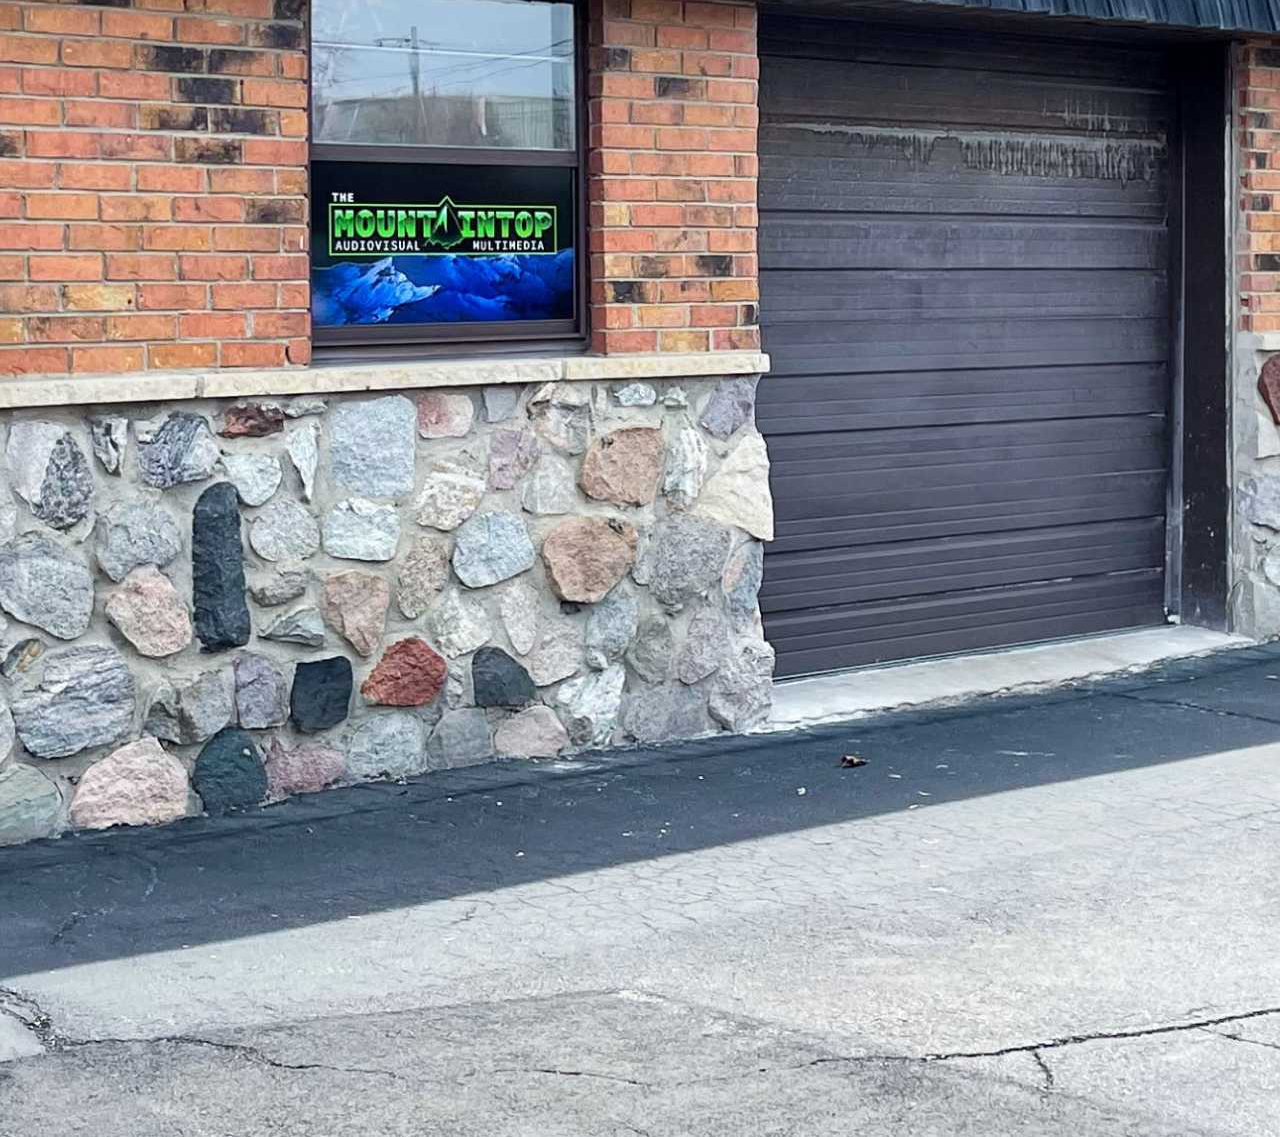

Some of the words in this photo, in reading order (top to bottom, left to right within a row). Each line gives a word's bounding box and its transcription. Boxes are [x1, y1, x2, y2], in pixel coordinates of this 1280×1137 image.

[331, 192, 355, 203] THE
[334, 240, 421, 252] AUDIOVISUAL
[472, 239, 545, 252] MULTIMEDIA
